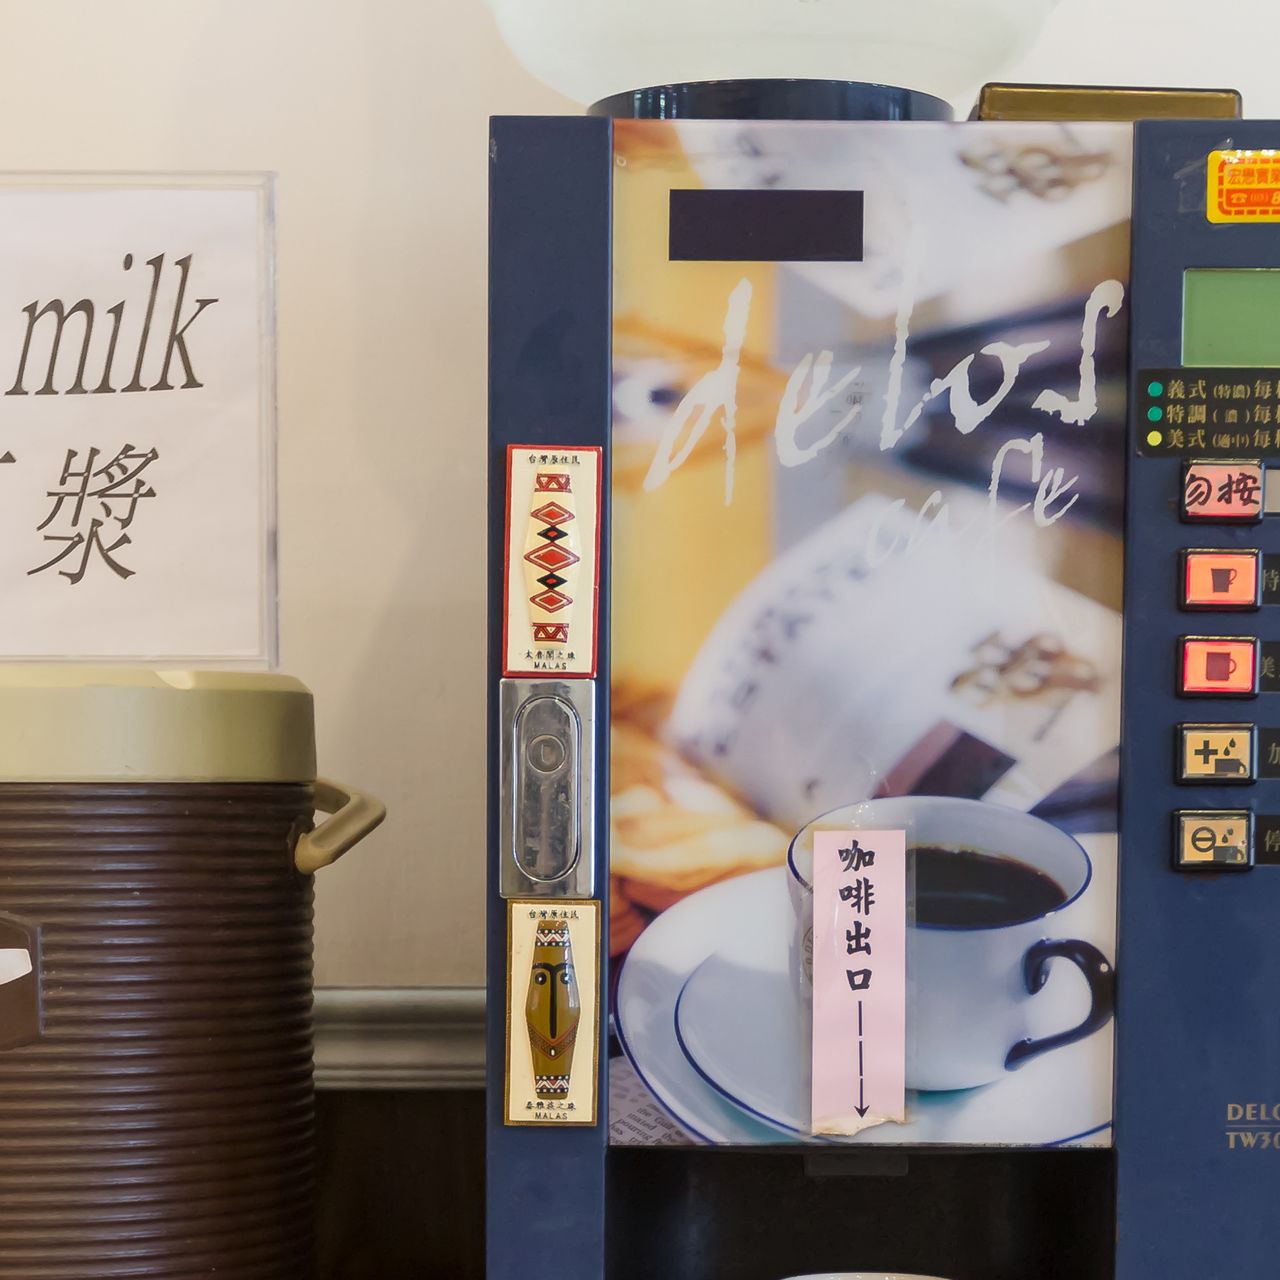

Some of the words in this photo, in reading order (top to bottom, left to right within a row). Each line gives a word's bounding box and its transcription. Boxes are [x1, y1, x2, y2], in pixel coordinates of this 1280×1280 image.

[4, 252, 219, 396] milk
[1185, 473, 1261, 507] 勿按
[534, 661, 567, 671] MALAS
[838, 839, 876, 991] 咖啡出口
[535, 1112, 568, 1121] MALAS
